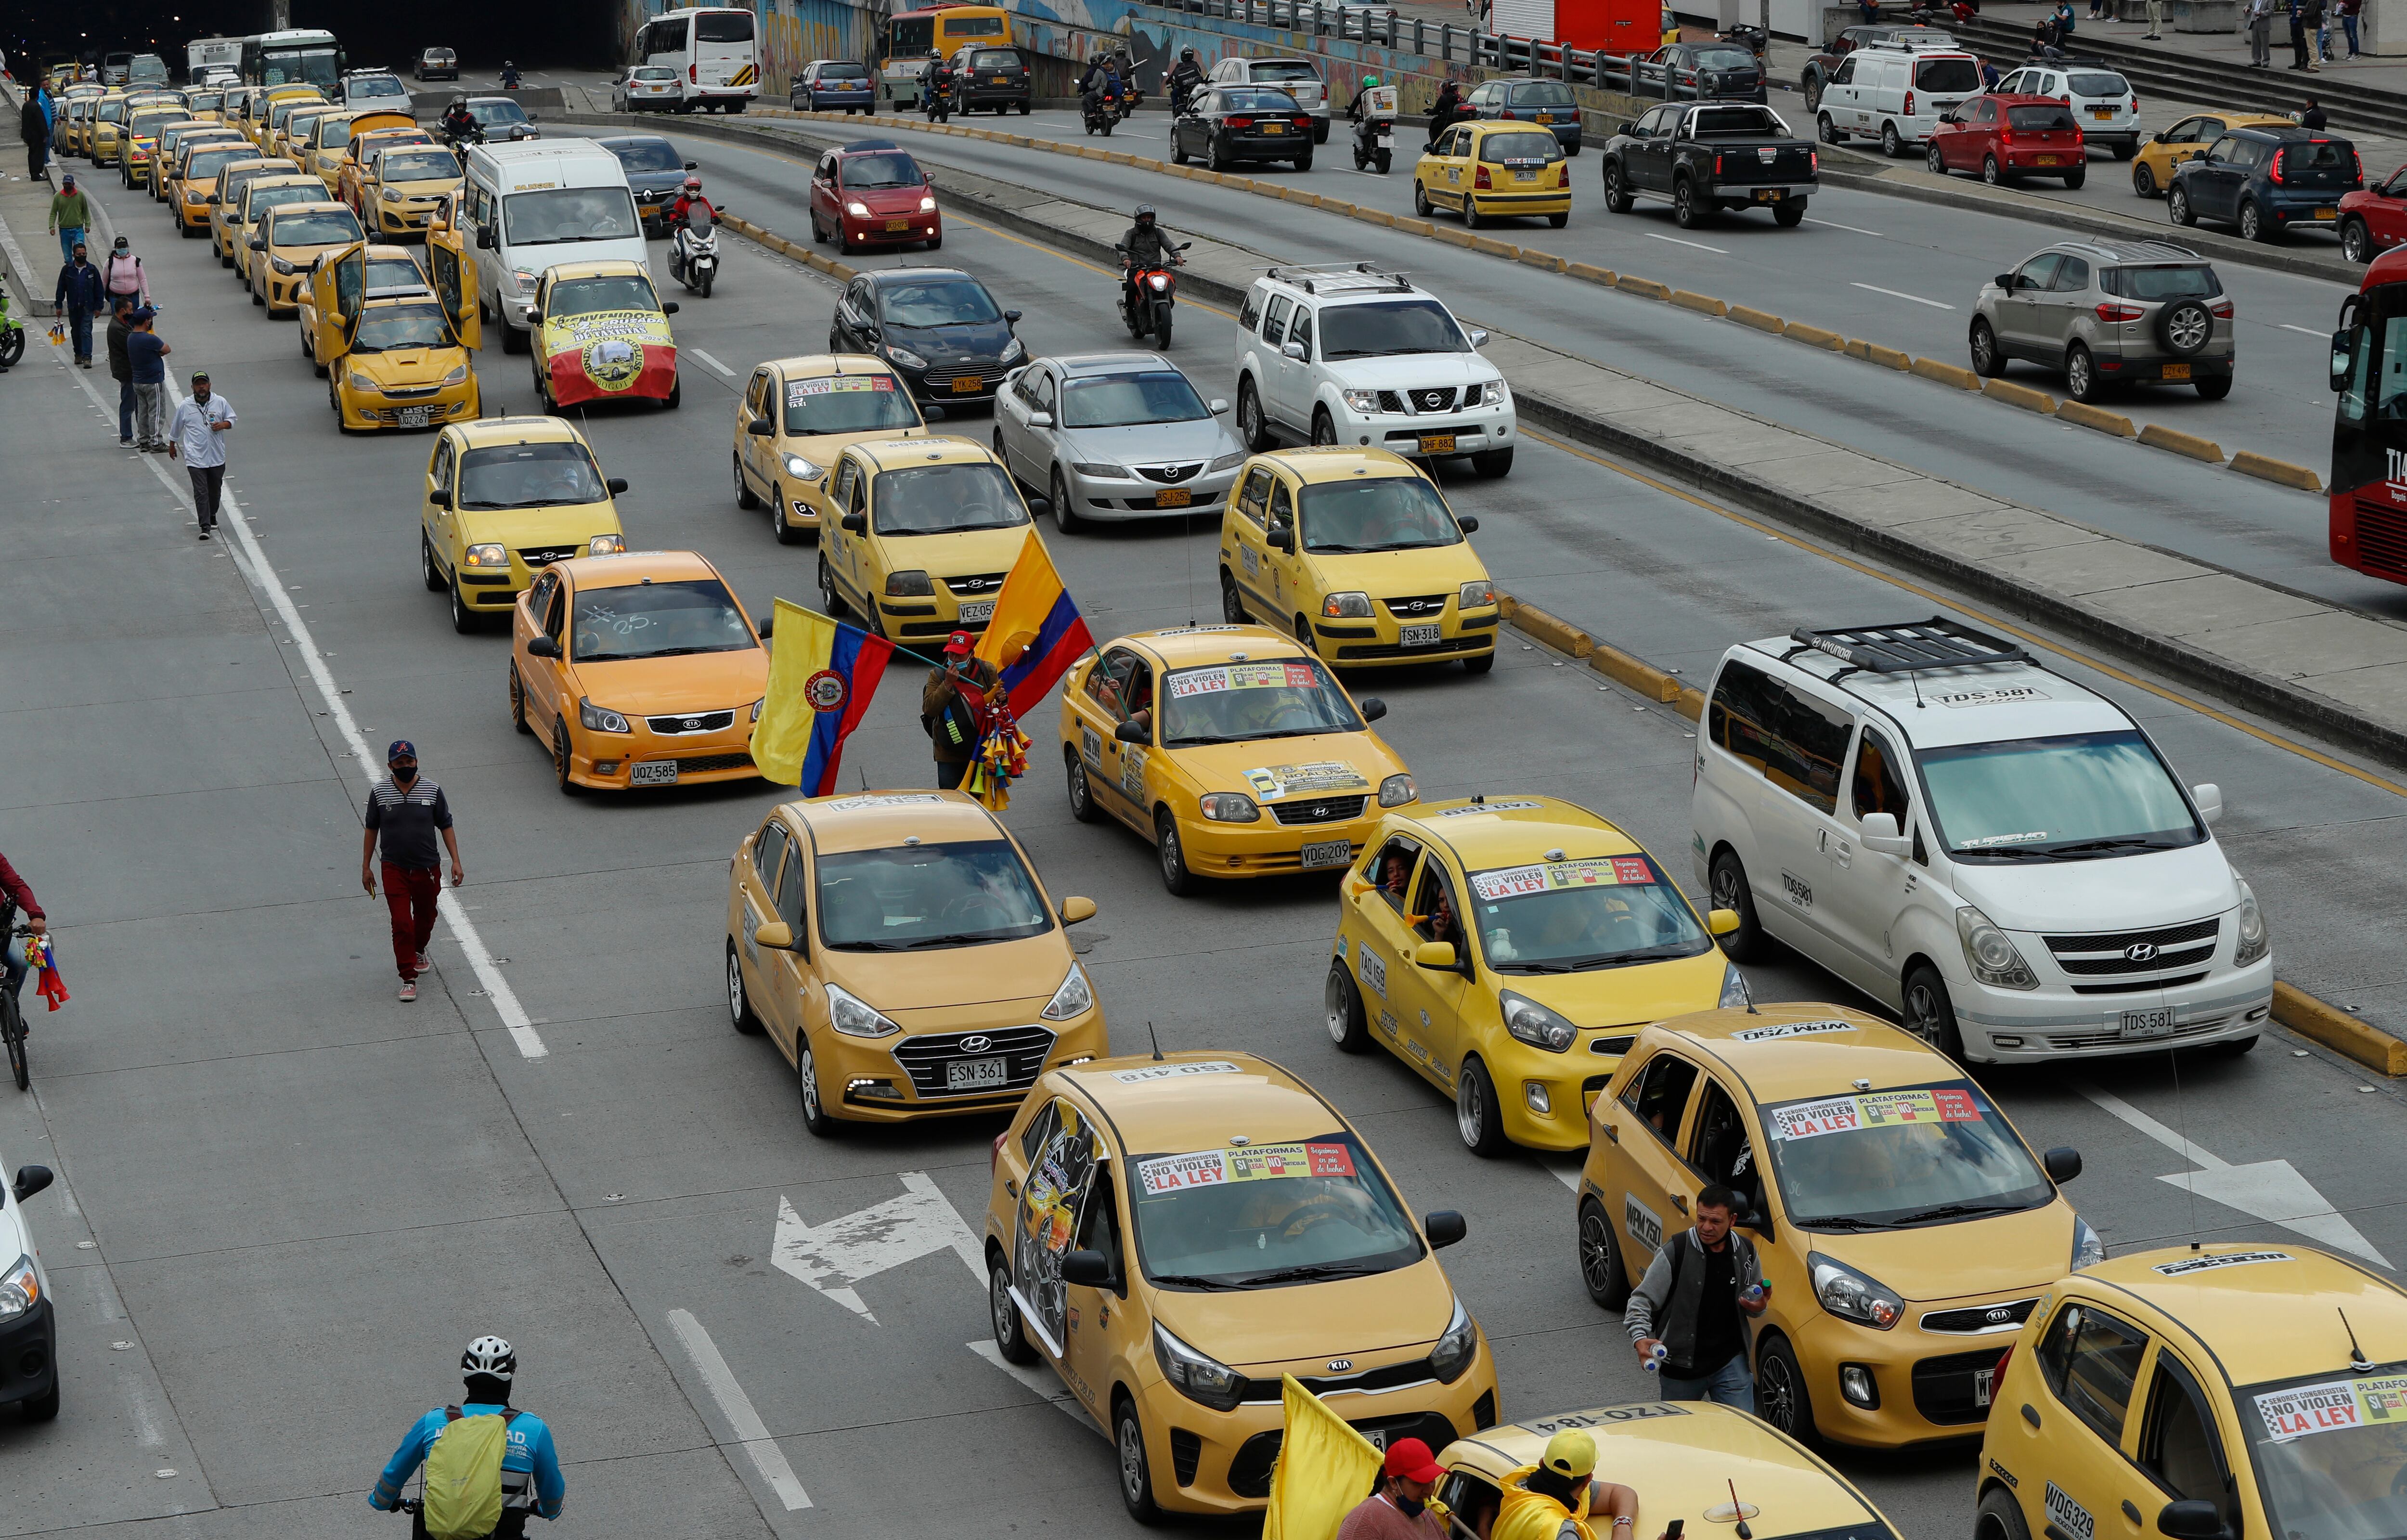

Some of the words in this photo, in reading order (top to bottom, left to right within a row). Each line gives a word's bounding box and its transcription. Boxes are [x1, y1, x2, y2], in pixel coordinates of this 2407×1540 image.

[594, 327, 647, 337] TAXISTAS
[582, 336, 610, 375] SINDICATO
[1821, 640, 1853, 661] HYUNDAI
[1177, 678, 1190, 686] NO
[1192, 673, 1226, 683] VIOLEN
[1256, 673, 1267, 681] NO
[1179, 685, 1198, 695] LA
[1202, 680, 1226, 691] LEY
[1938, 687, 2034, 703] TDS-581
[1974, 696, 2026, 704] COTA
[946, 720, 963, 745] PUMA
[397, 743, 408, 752] A
[1961, 832, 2047, 849] TURISMO
[1547, 861, 1609, 870] PLATAFORMAS
[1481, 872, 1503, 881] SEÑORES
[1504, 867, 1540, 877] CONGRESISTAS
[1484, 878, 1500, 887] NO
[1502, 871, 1543, 883] VIOLEN
[1555, 872, 1565, 881] SI
[1581, 868, 1592, 878] NO
[1487, 884, 1511, 897] LA
[1514, 878, 1545, 893] LEY
[1792, 896, 1803, 906] COTA
[1373, 965, 1385, 987] 159
[1744, 1028, 1789, 1040] 750
[1793, 1023, 1850, 1033] WPM
[1407, 1039, 1428, 1060] SERVICIO
[1431, 1057, 1450, 1078] PUBLICO
[1181, 1063, 1239, 1074] ESO
[1121, 1070, 1171, 1082] 418
[1858, 1093, 1930, 1104] PLATAFORMAS
[1936, 1093, 1963, 1101] Seguimos
[1784, 1106, 1810, 1116] SEÑORES
[1810, 1100, 1851, 1111] CONGRESISTAS
[1786, 1113, 1806, 1123] NO
[1808, 1105, 1854, 1120] VIOLEN
[1868, 1107, 1879, 1117] SI
[1897, 1103, 1911, 1113] NO
[1954, 1110, 1972, 1119] lucha!
[1790, 1121, 1819, 1136] LA
[1824, 1114, 1857, 1130] LEY
[1228, 1147, 1303, 1158] PLATAFORMAS
[1310, 1147, 1339, 1155] Seguimos
[1149, 1160, 1176, 1169] SEÑORES
[1177, 1153, 1219, 1165] CONGRESISTAS
[1236, 1160, 1247, 1170] SI
[1267, 1156, 1282, 1167] NO
[1328, 1156, 1338, 1165] pie
[1152, 1165, 1172, 1177] NO
[1175, 1159, 1222, 1173] VIOLEN
[1327, 1164, 1345, 1173] lucha!
[1155, 1174, 1182, 1190] LA
[1189, 1167, 1222, 1184] LEY
[1627, 1200, 1646, 1235] WPM
[1646, 1218, 1661, 1245] 750
[1991, 1311, 2007, 1320] KIA
[1331, 1361, 1349, 1370] KIA
[1061, 1358, 1078, 1384] SERVICIO
[1078, 1379, 1096, 1404] PUBLICO
[2268, 1393, 2299, 1405] SEÑORES
[2299, 1386, 2348, 1399] CONGRESISTAS
[2271, 1402, 2295, 1416] NO
[2298, 1393, 2353, 1411] VIOLEN
[2370, 1396, 2382, 1410] SI
[2384, 1400, 2403, 1408] LEGAL
[2277, 1412, 2312, 1434] LA
[2314, 1405, 2356, 1427] LEY
[2045, 1482, 2094, 1538] WDG329
[2055, 1515, 2074, 1535] BOGOTA
